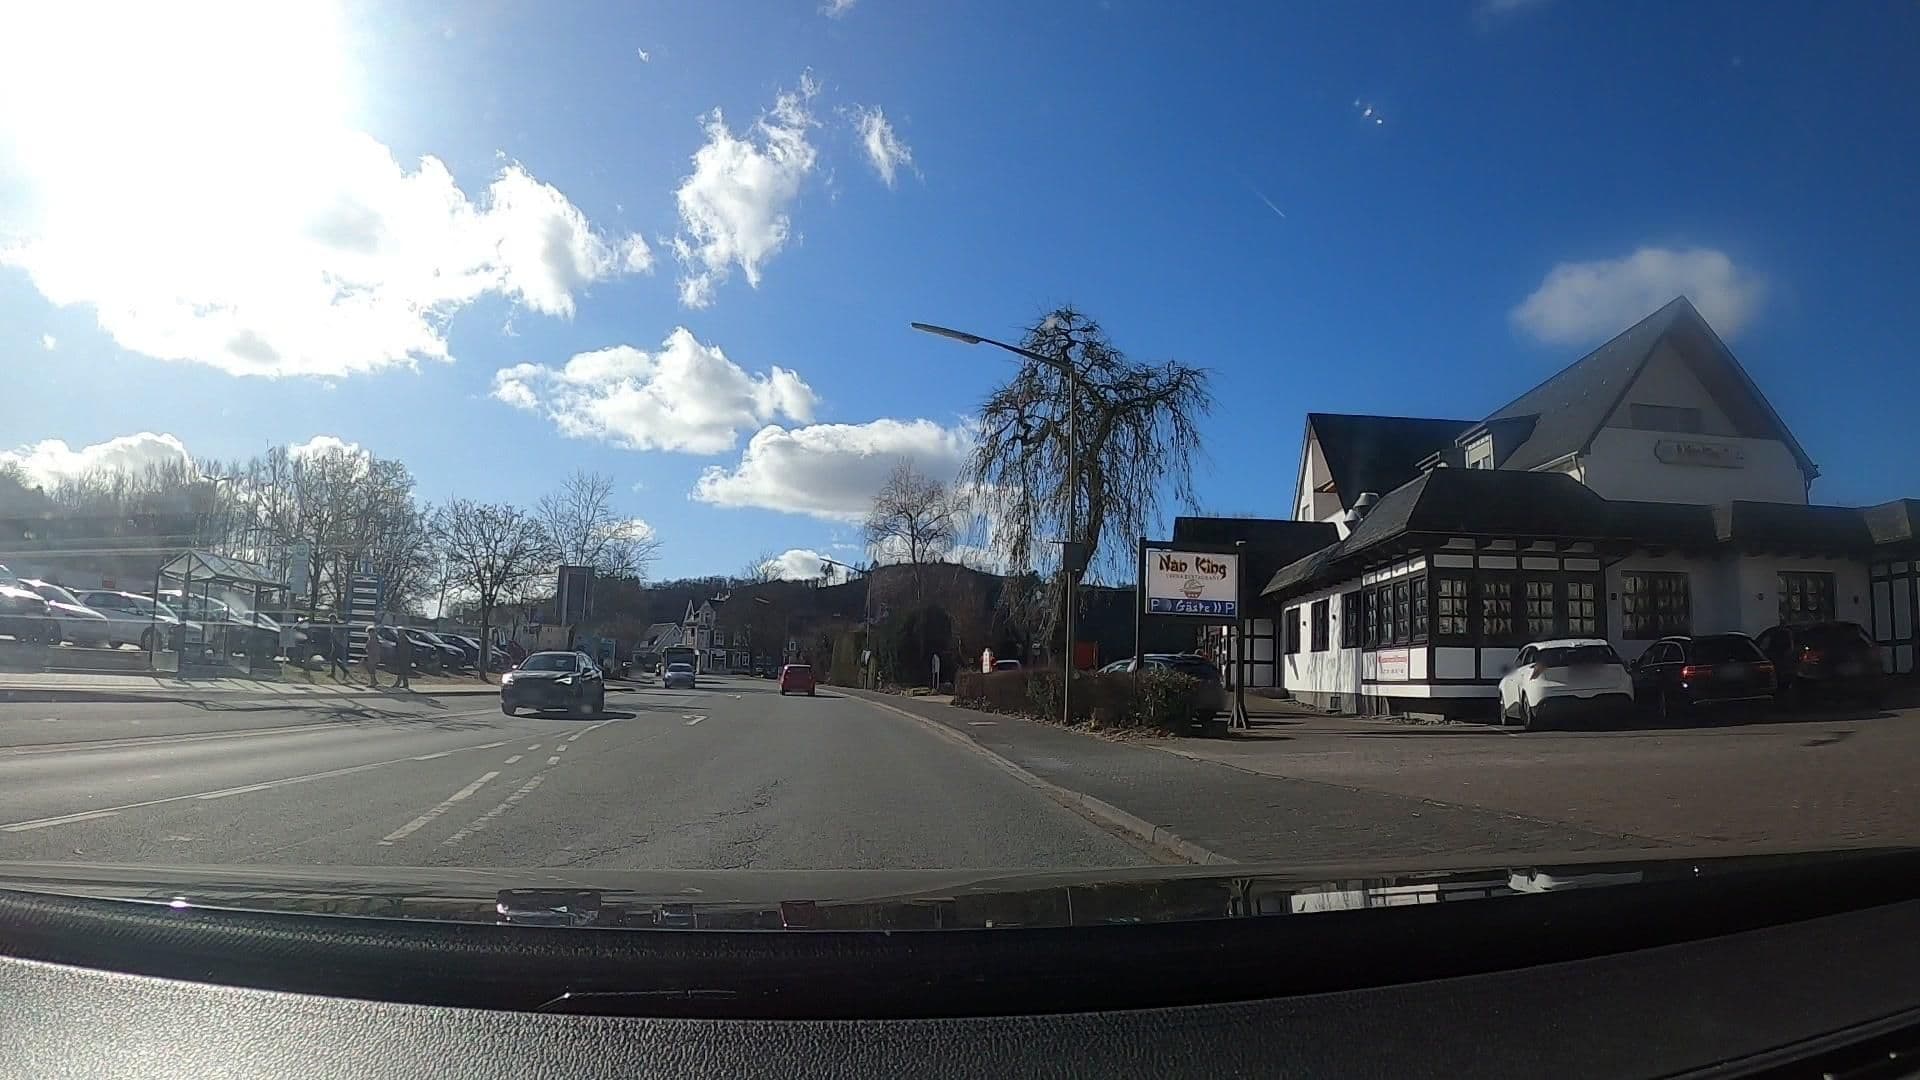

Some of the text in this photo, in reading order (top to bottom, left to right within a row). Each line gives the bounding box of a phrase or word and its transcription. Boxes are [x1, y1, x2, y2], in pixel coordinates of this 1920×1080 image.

[1159, 554, 1227, 579] Nan King
[1150, 599, 1160, 611] P
[1225, 603, 1235, 614] P
